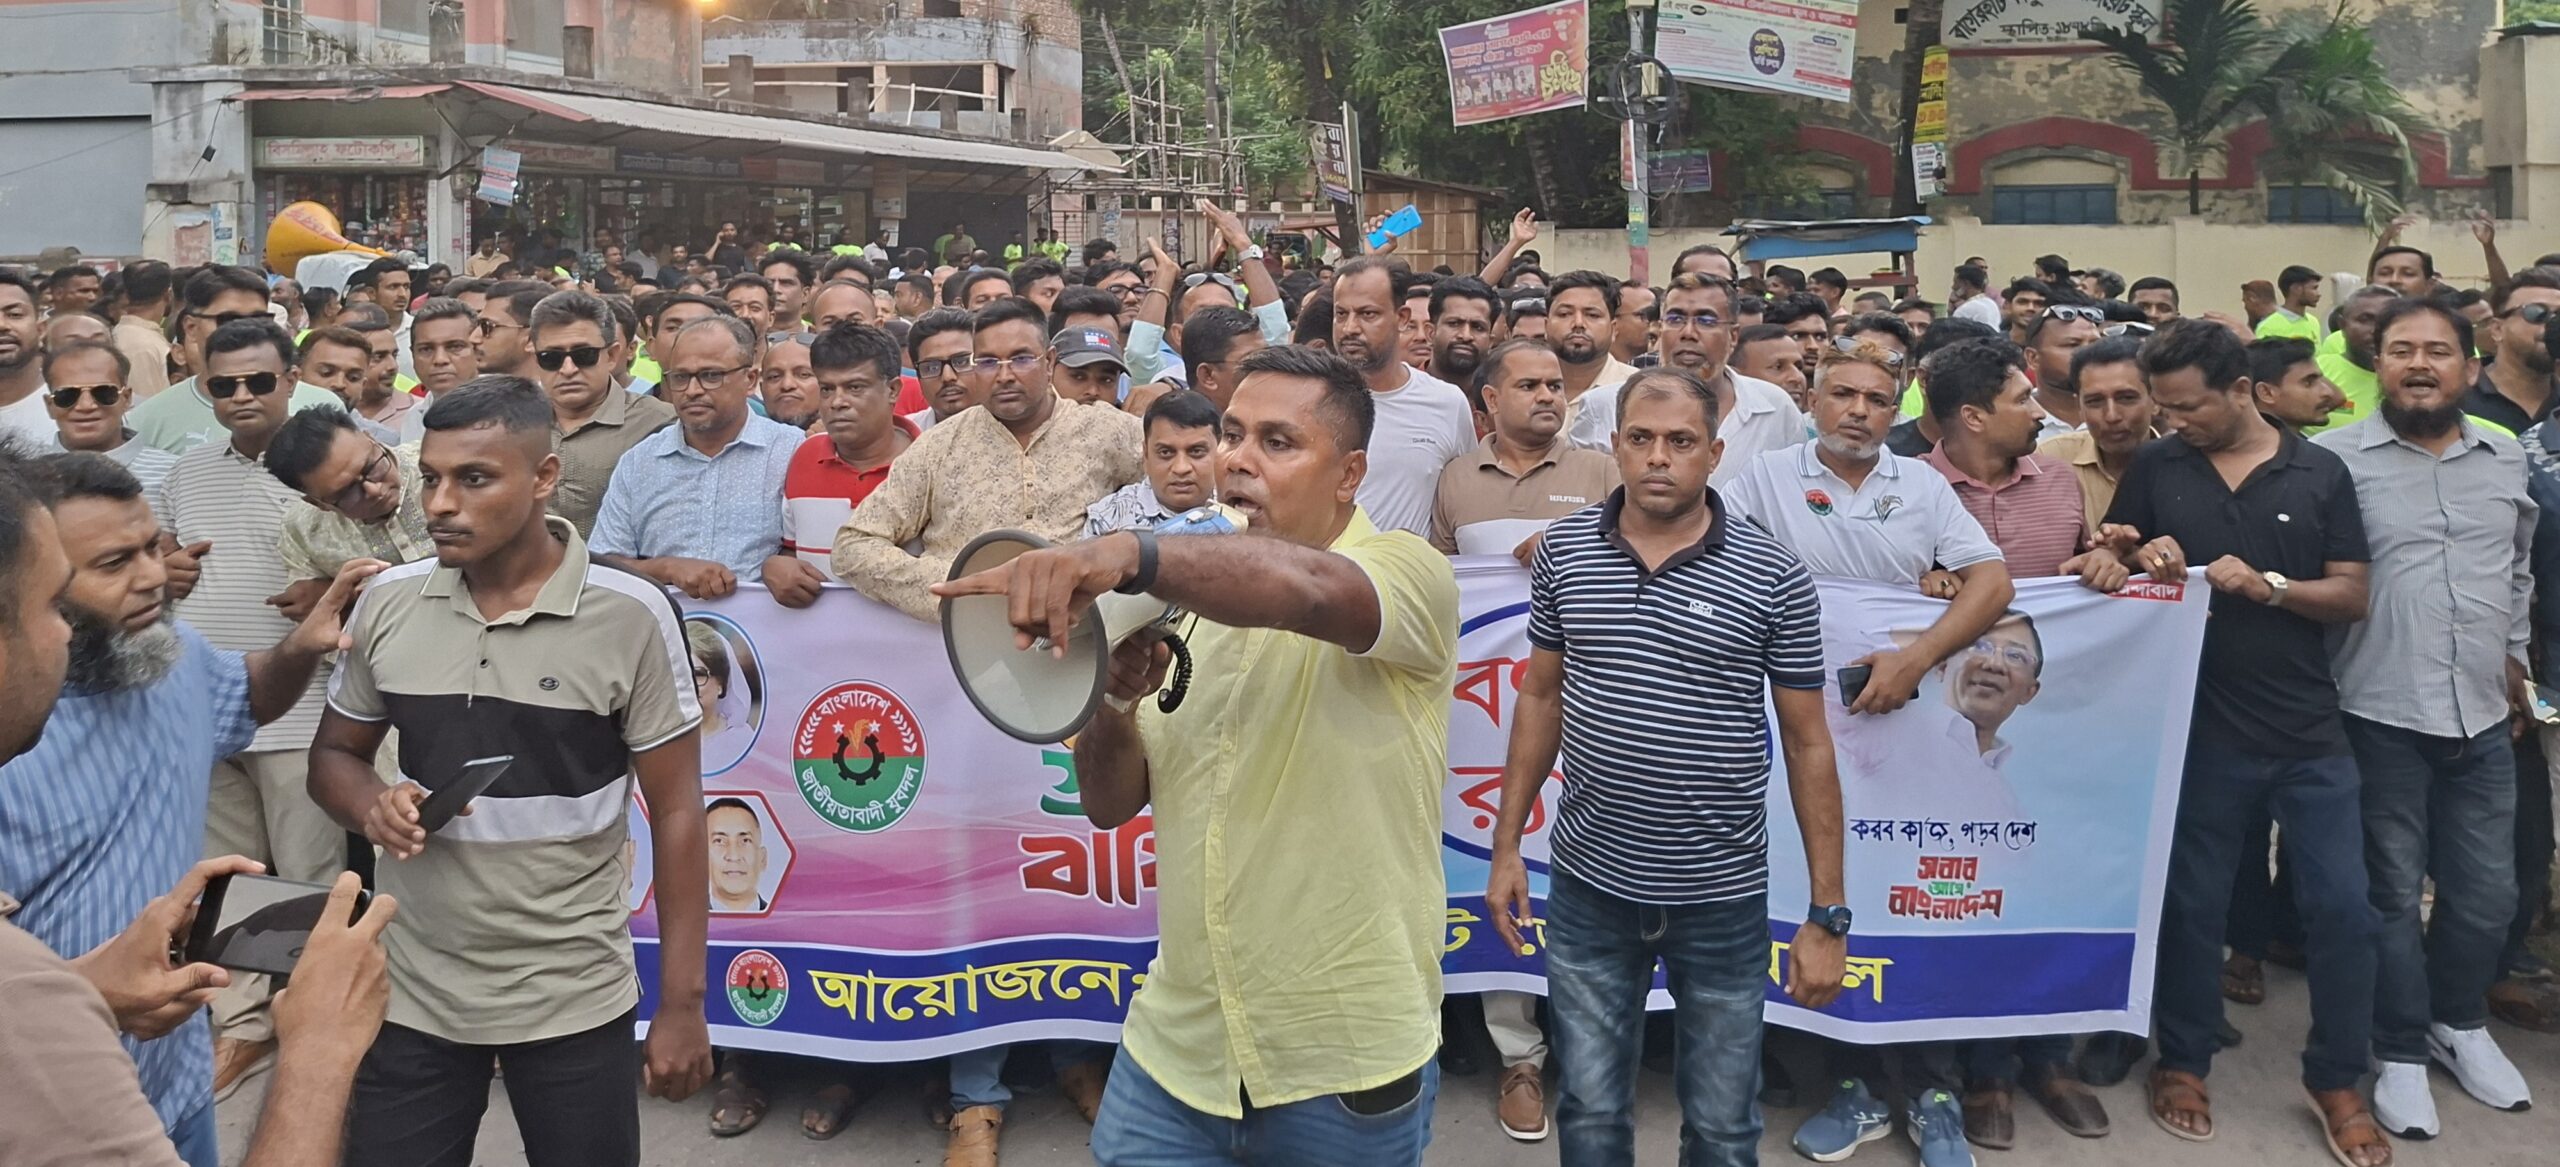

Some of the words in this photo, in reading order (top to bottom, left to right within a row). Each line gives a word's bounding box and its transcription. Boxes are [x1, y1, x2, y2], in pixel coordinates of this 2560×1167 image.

[817, 690, 891, 717] বাংলাদেশ
[802, 765, 886, 825] জাতীয়তাবাদী
[886, 763, 920, 814] যুবদল
[1850, 818, 1895, 842] করব
[1961, 821, 2001, 847] গড়ব
[2004, 821, 2038, 850] দেশ
[1917, 855, 1979, 882] সবার
[1888, 885, 2004, 921] বাংলাদেশ
